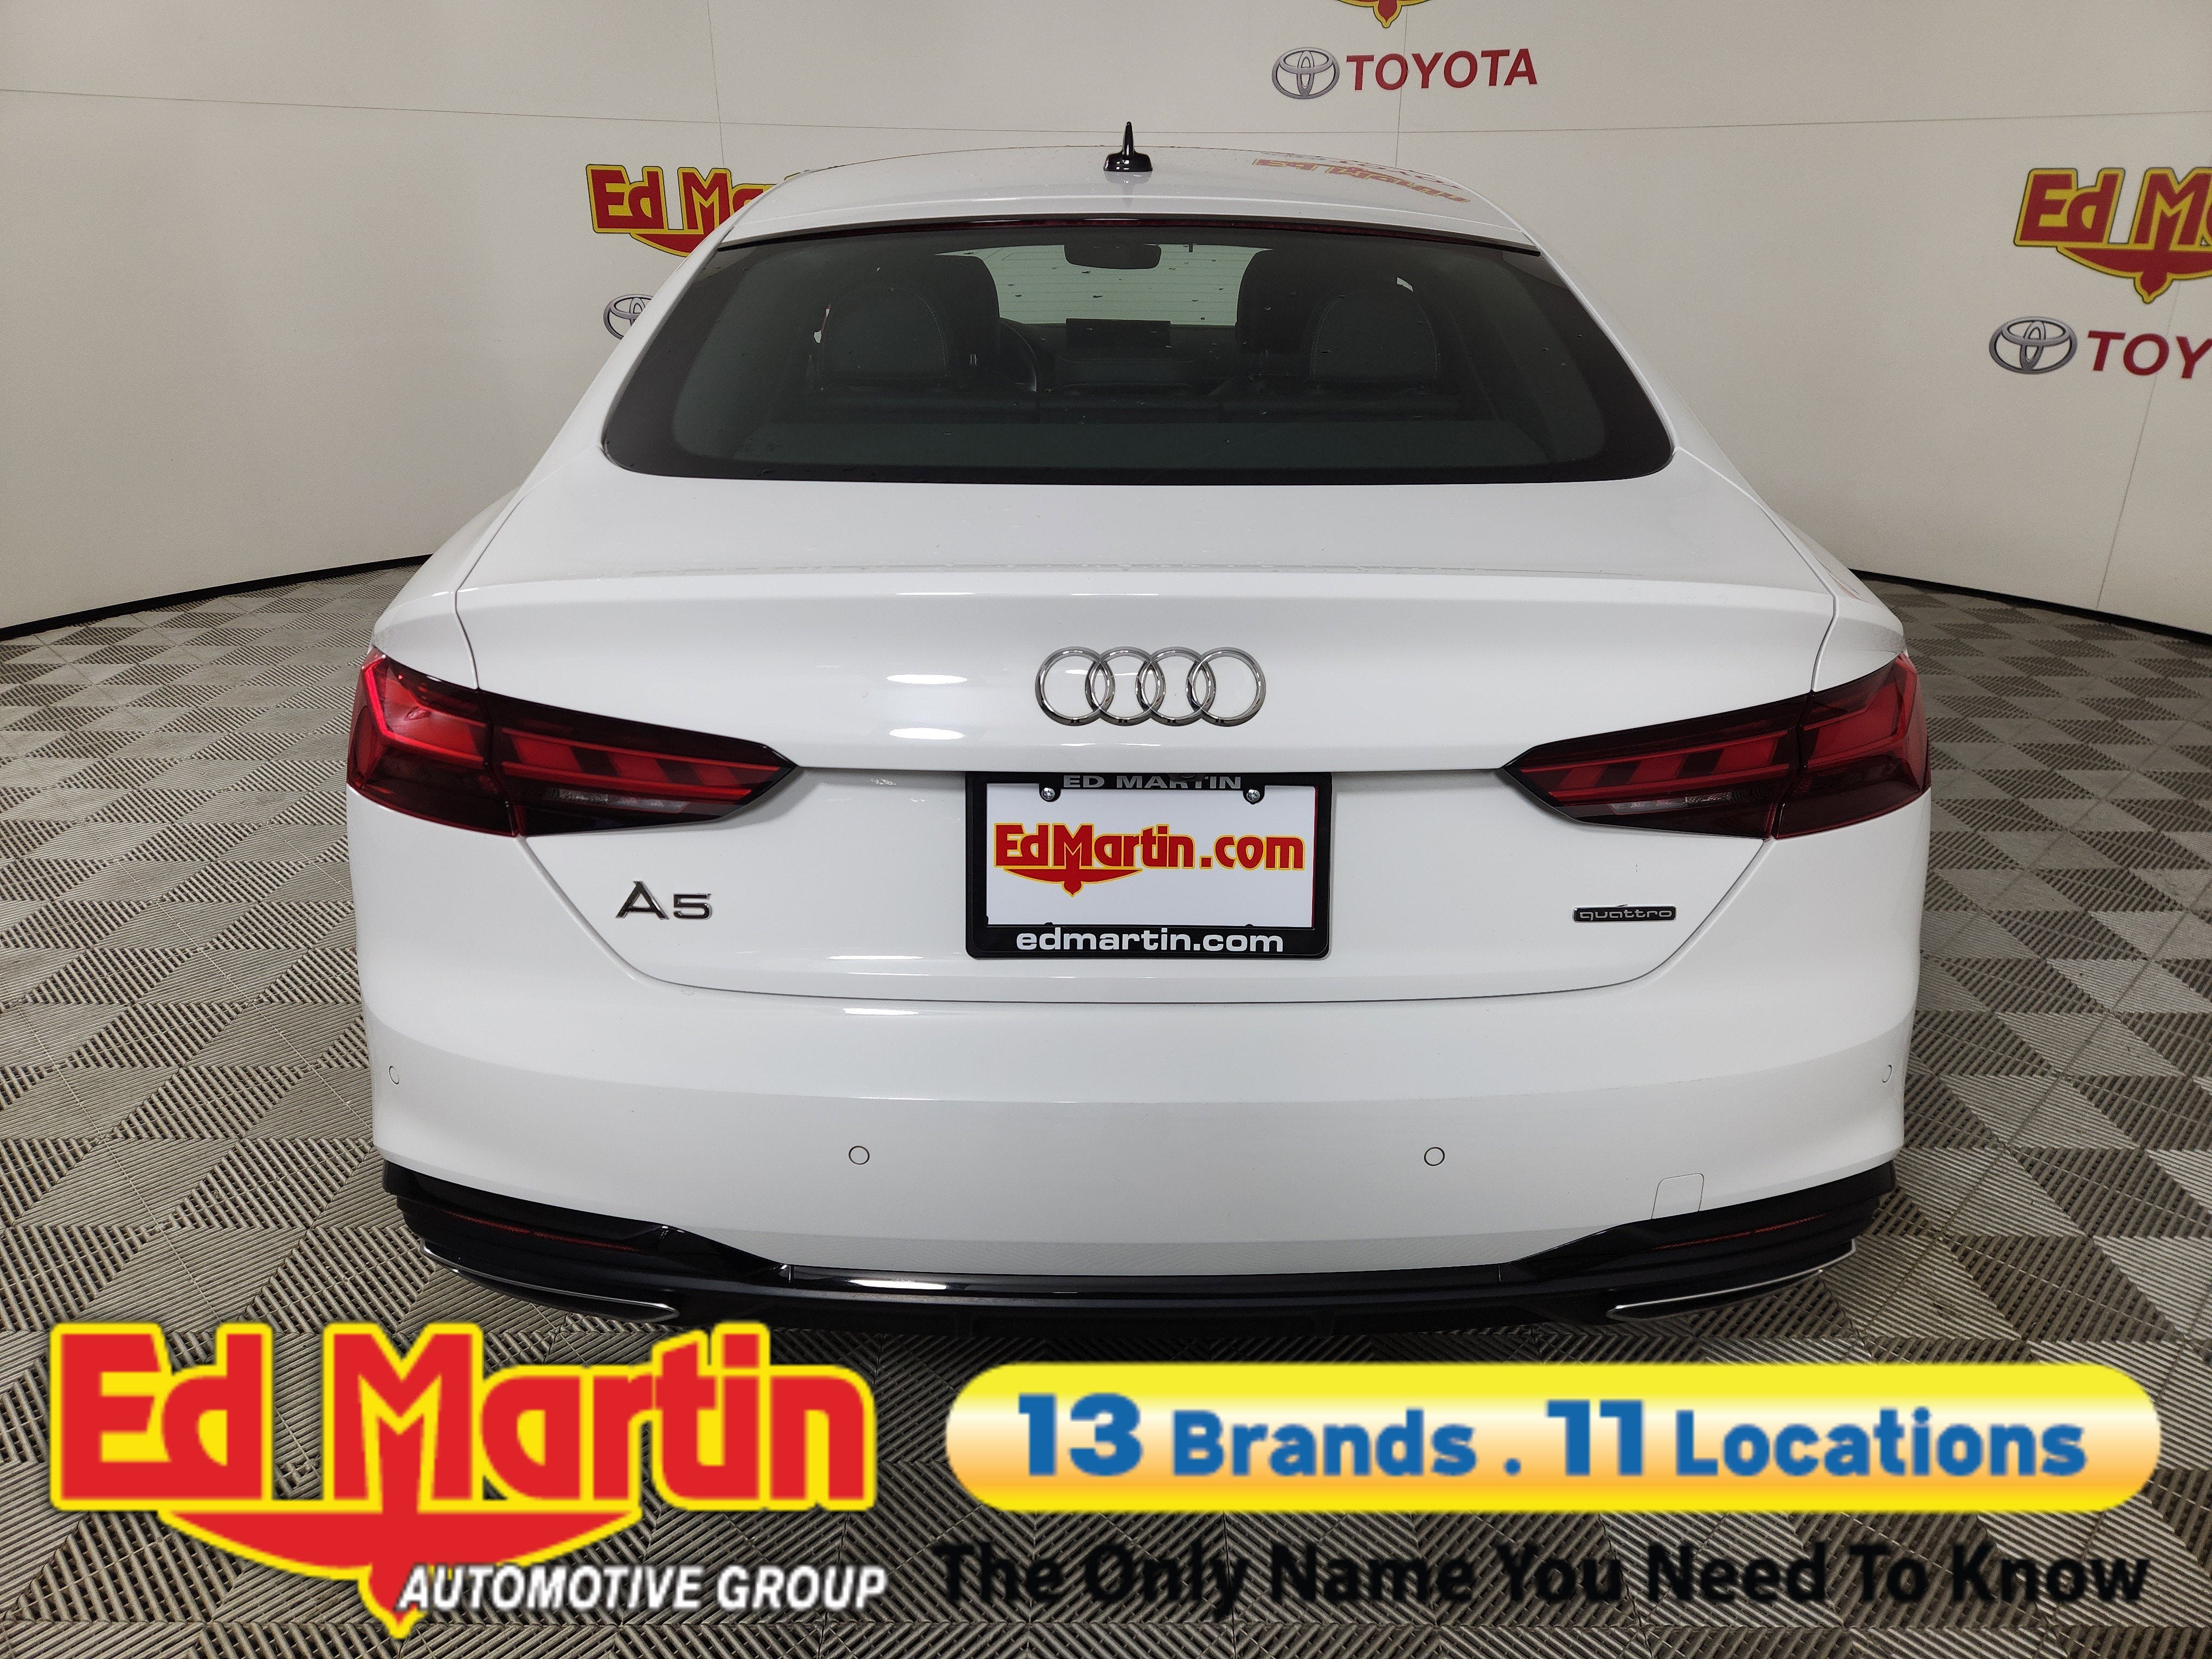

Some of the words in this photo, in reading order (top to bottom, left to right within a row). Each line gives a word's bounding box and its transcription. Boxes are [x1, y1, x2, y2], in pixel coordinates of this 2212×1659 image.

[1346, 48, 1538, 91] TOYOTA
[586, 164, 668, 233] Ed
[677, 167, 779, 233] Ma
[2014, 168, 2125, 247] Ed
[1063, 775, 1105, 788] ED
[615, 880, 713, 920] A5
[1579, 909, 1673, 921] quattro
[1016, 927, 1284, 953] edmartin.com
